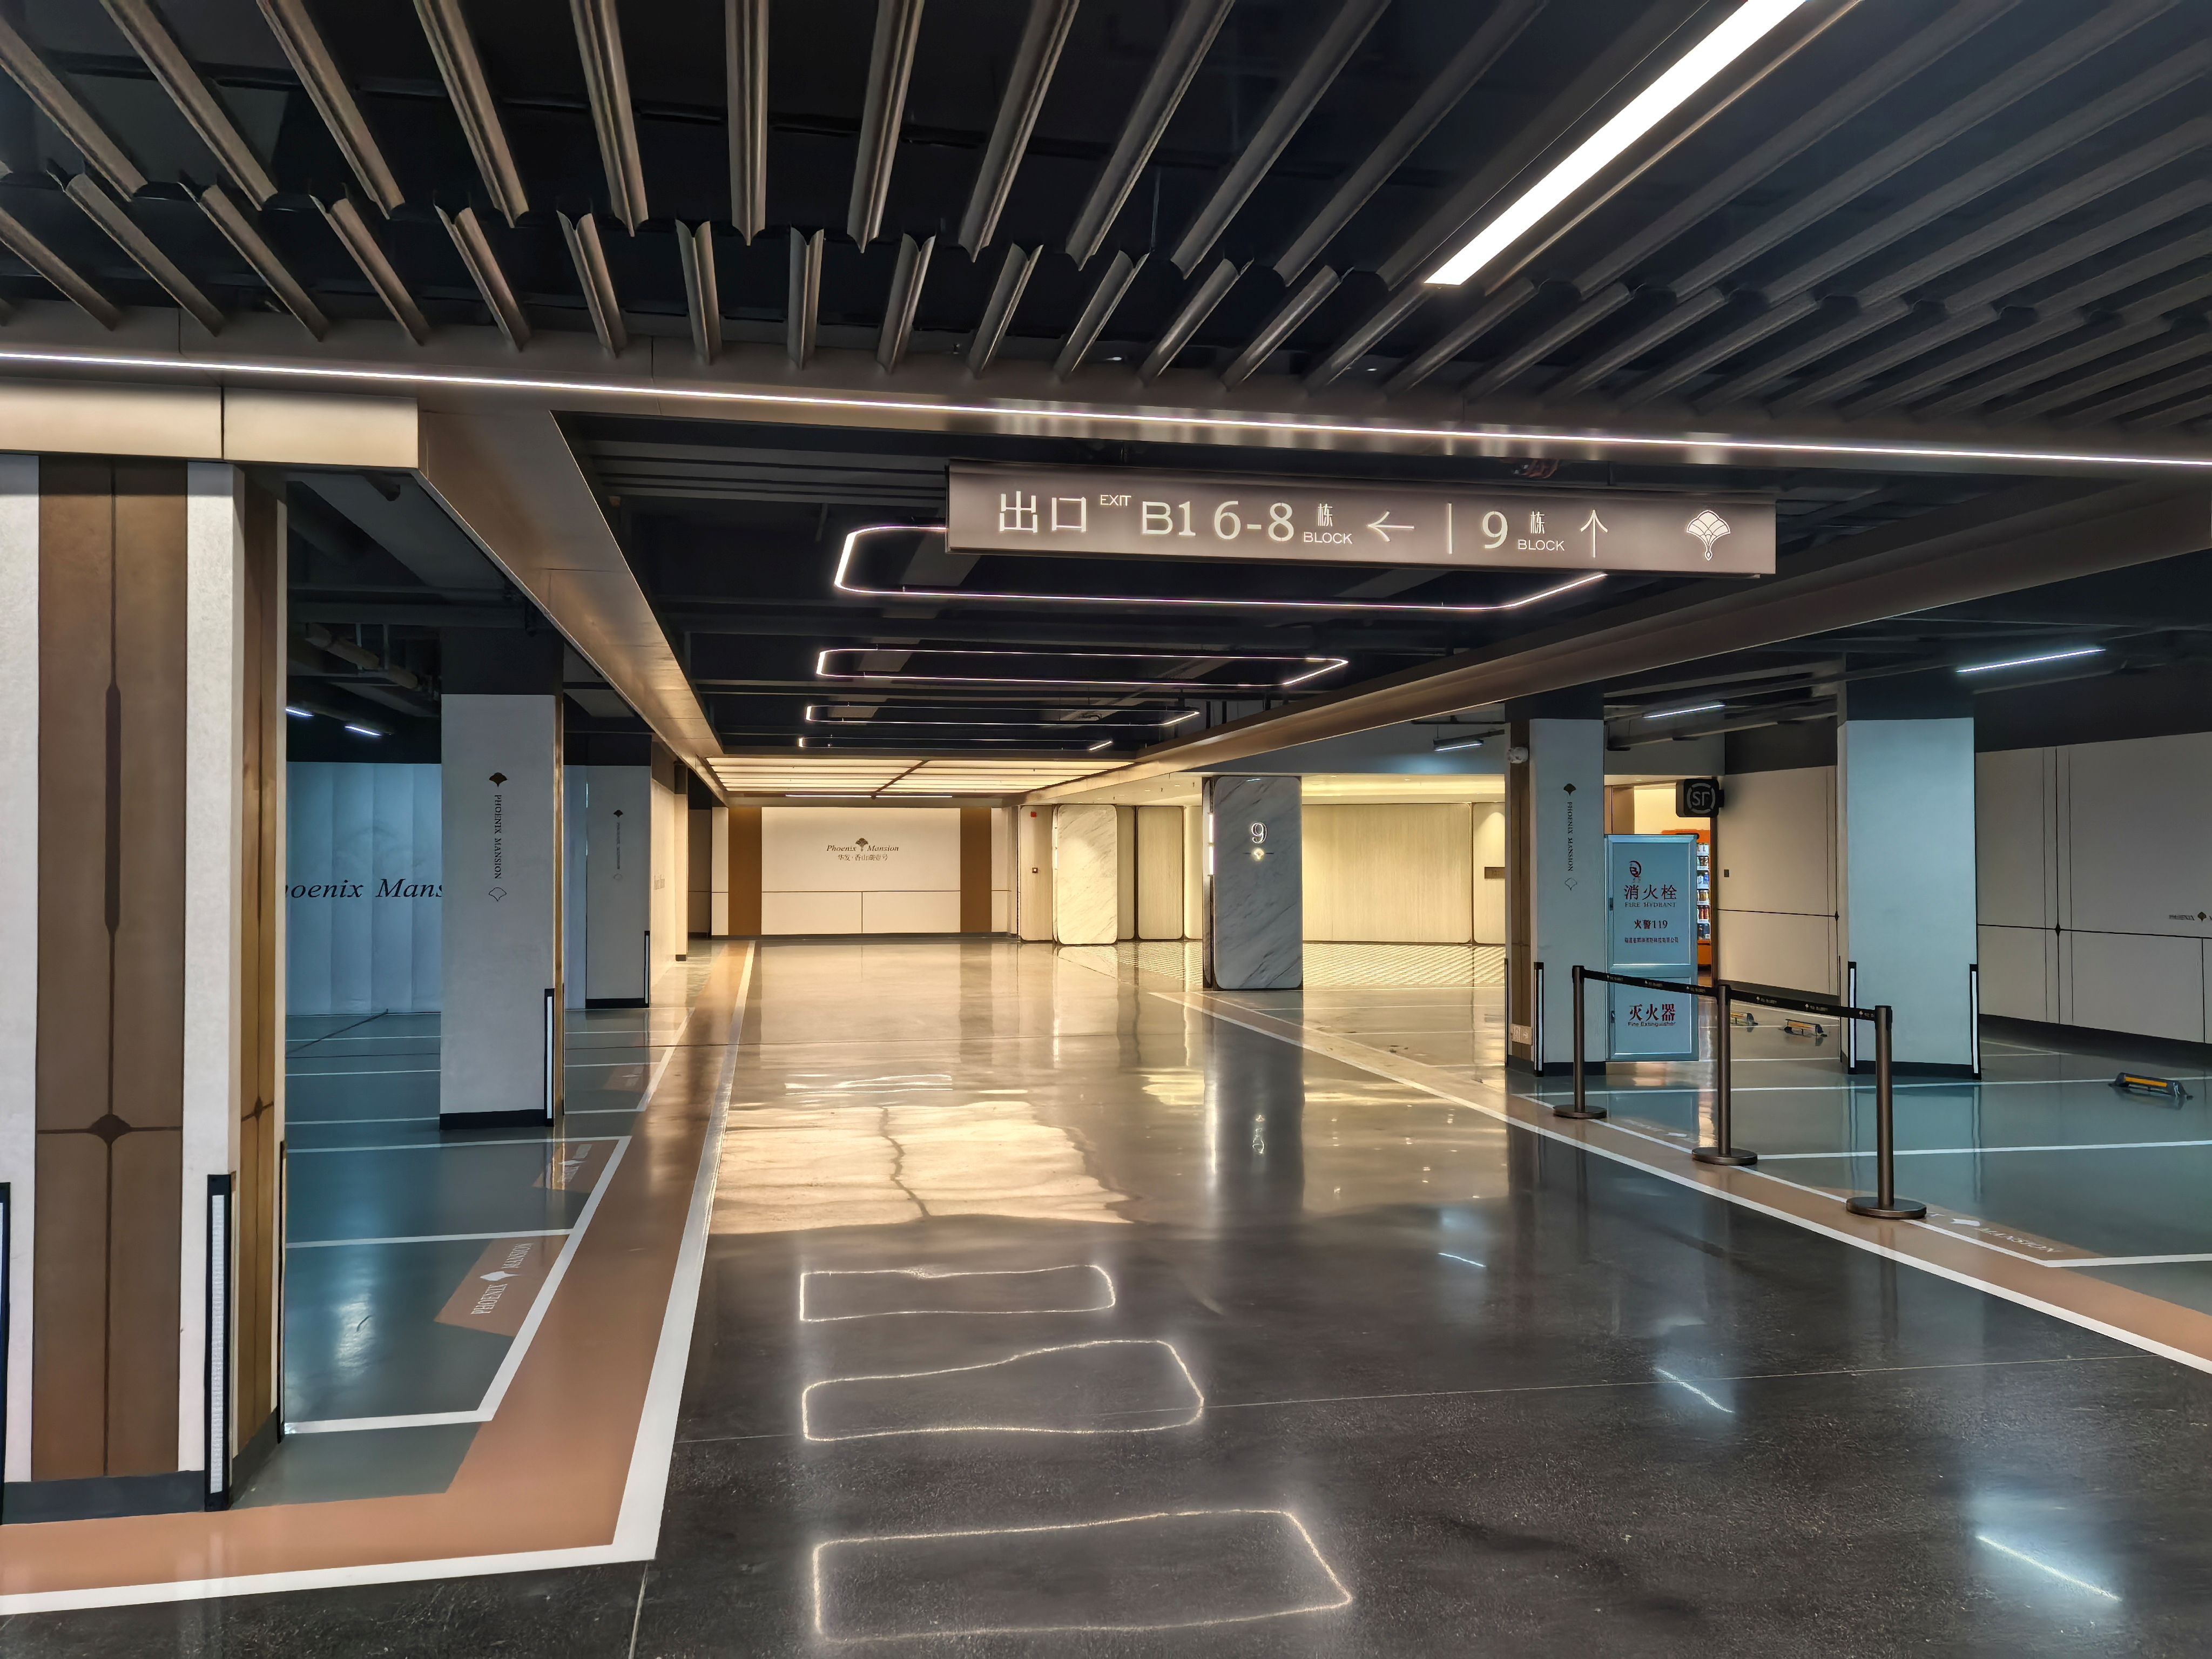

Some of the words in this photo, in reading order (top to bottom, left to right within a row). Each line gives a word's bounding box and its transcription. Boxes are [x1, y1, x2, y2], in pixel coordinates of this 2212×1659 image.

[1100, 494, 1132, 507] EXIT
[999, 491, 1087, 533] 出口
[1142, 501, 1197, 536] B1
[1213, 500, 1294, 542] 6-8
[1318, 503, 1333, 527] 栋
[1530, 511, 1545, 534] 栋
[1303, 531, 1353, 544] BLOCK
[1482, 511, 1508, 549] 9
[1518, 539, 1565, 551] BLOCK
[494, 794, 502, 834] PHOENIX
[1251, 822, 1267, 844] 9
[285, 879, 364, 898] oenix
[1624, 884, 1677, 900] 消火栓
[1634, 919, 1668, 929] 火警119
[1629, 1003, 1676, 1021] 灭火器
[470, 1283, 508, 1314] PHOENIX
[501, 1243, 534, 1269] MANSION
